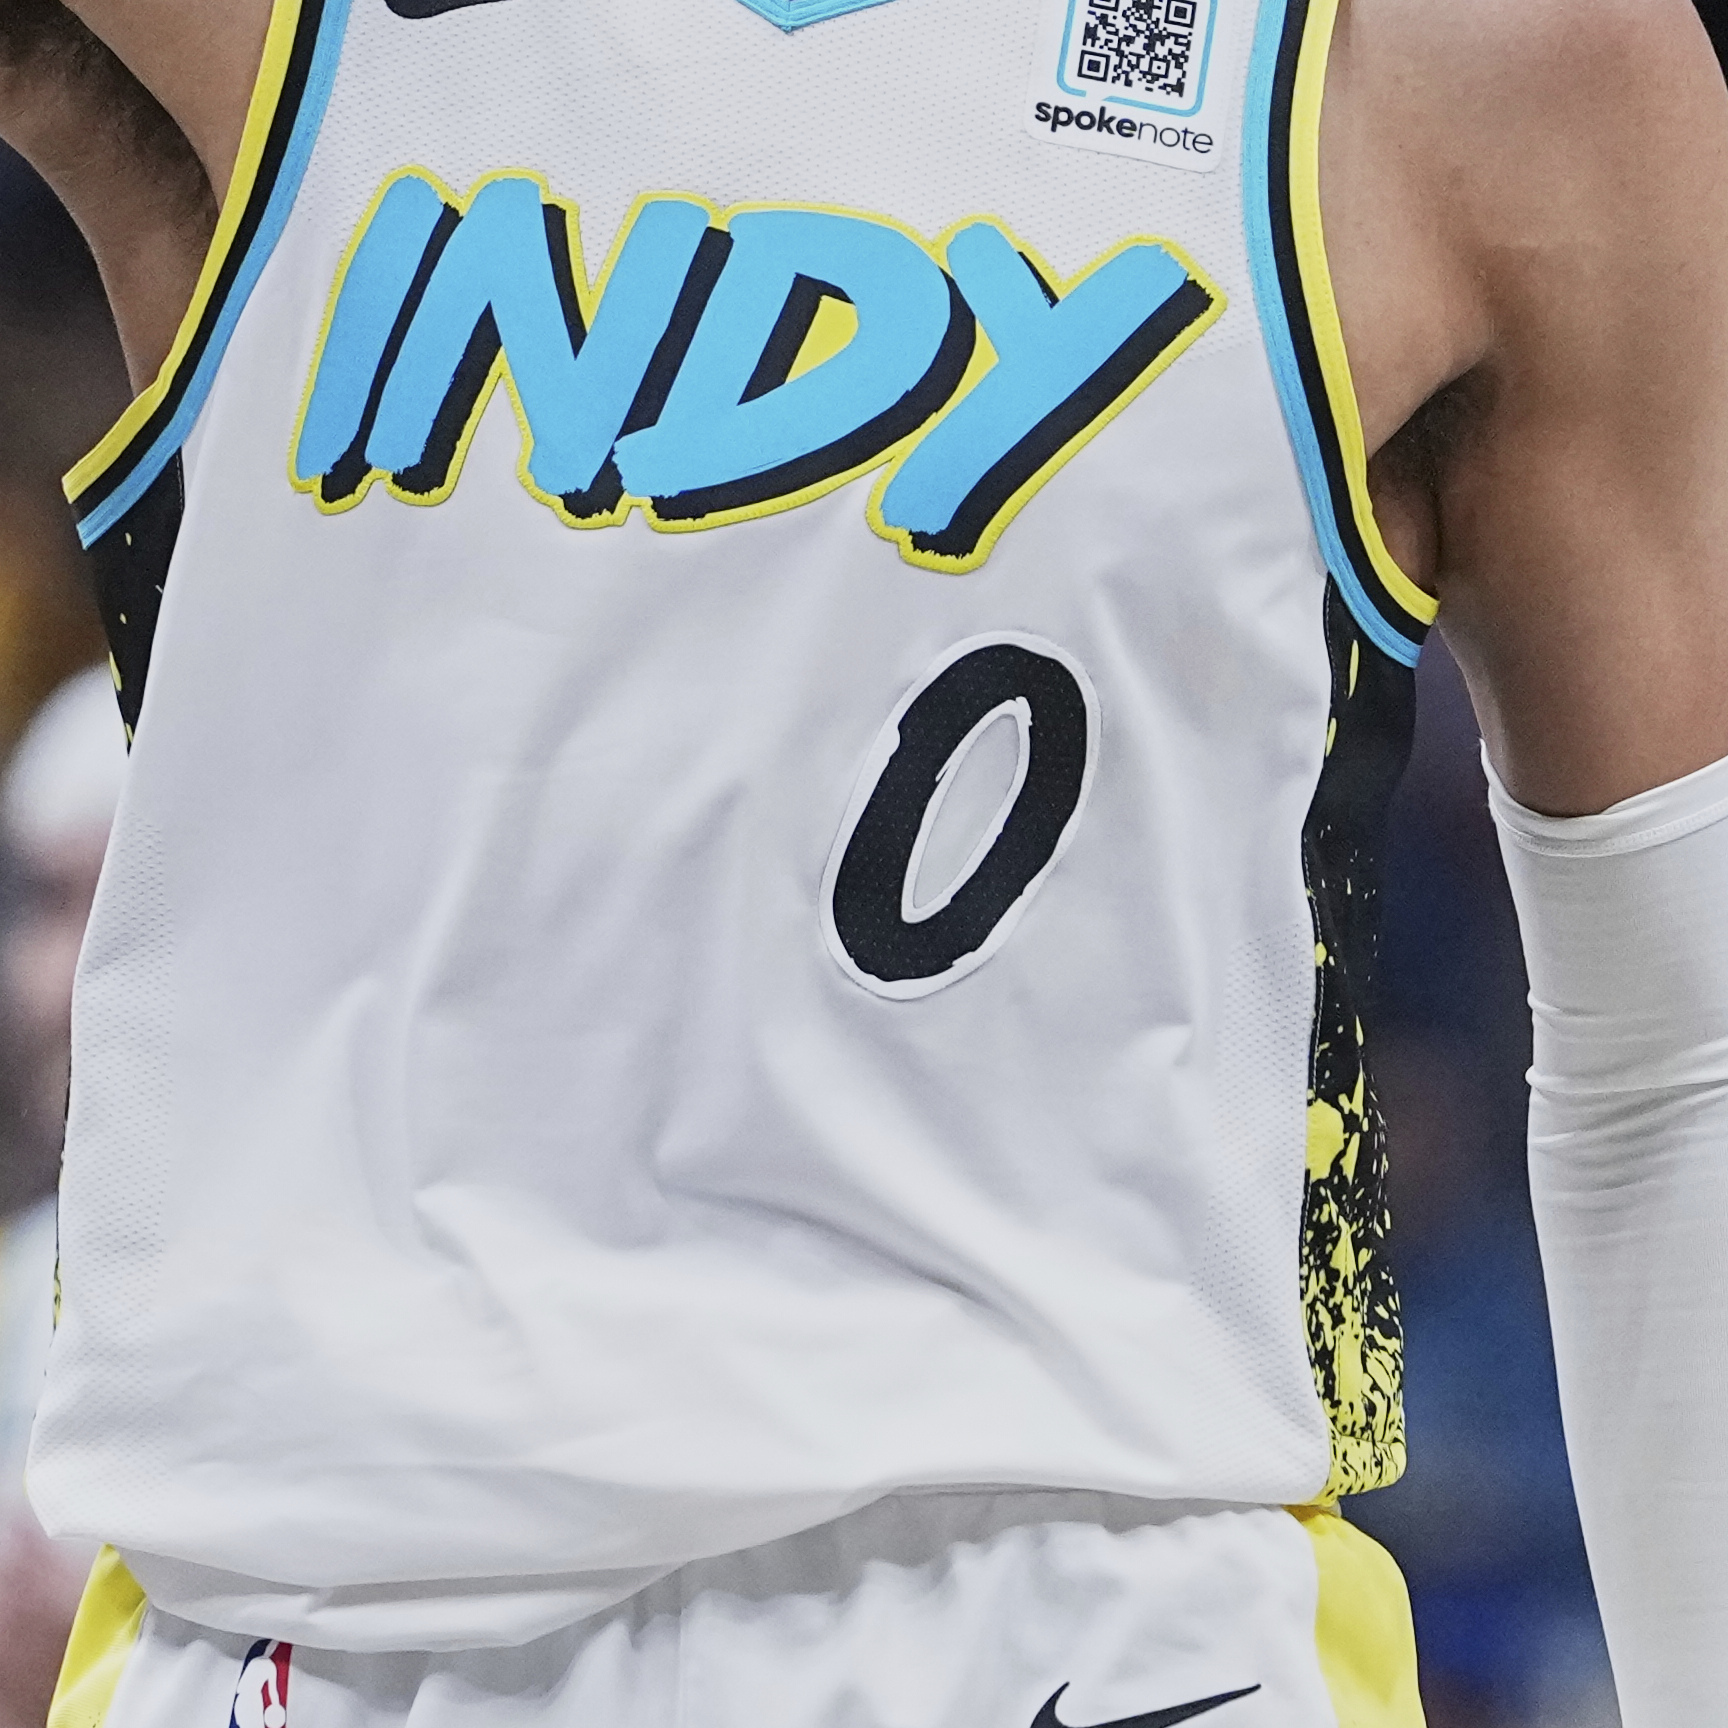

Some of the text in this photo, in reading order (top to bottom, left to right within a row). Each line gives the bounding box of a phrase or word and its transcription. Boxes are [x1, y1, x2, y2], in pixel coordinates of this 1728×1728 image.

[1035, 101, 1214, 154] spokenote
[288, 167, 1226, 572] INDY
[828, 639, 1092, 988] 0
